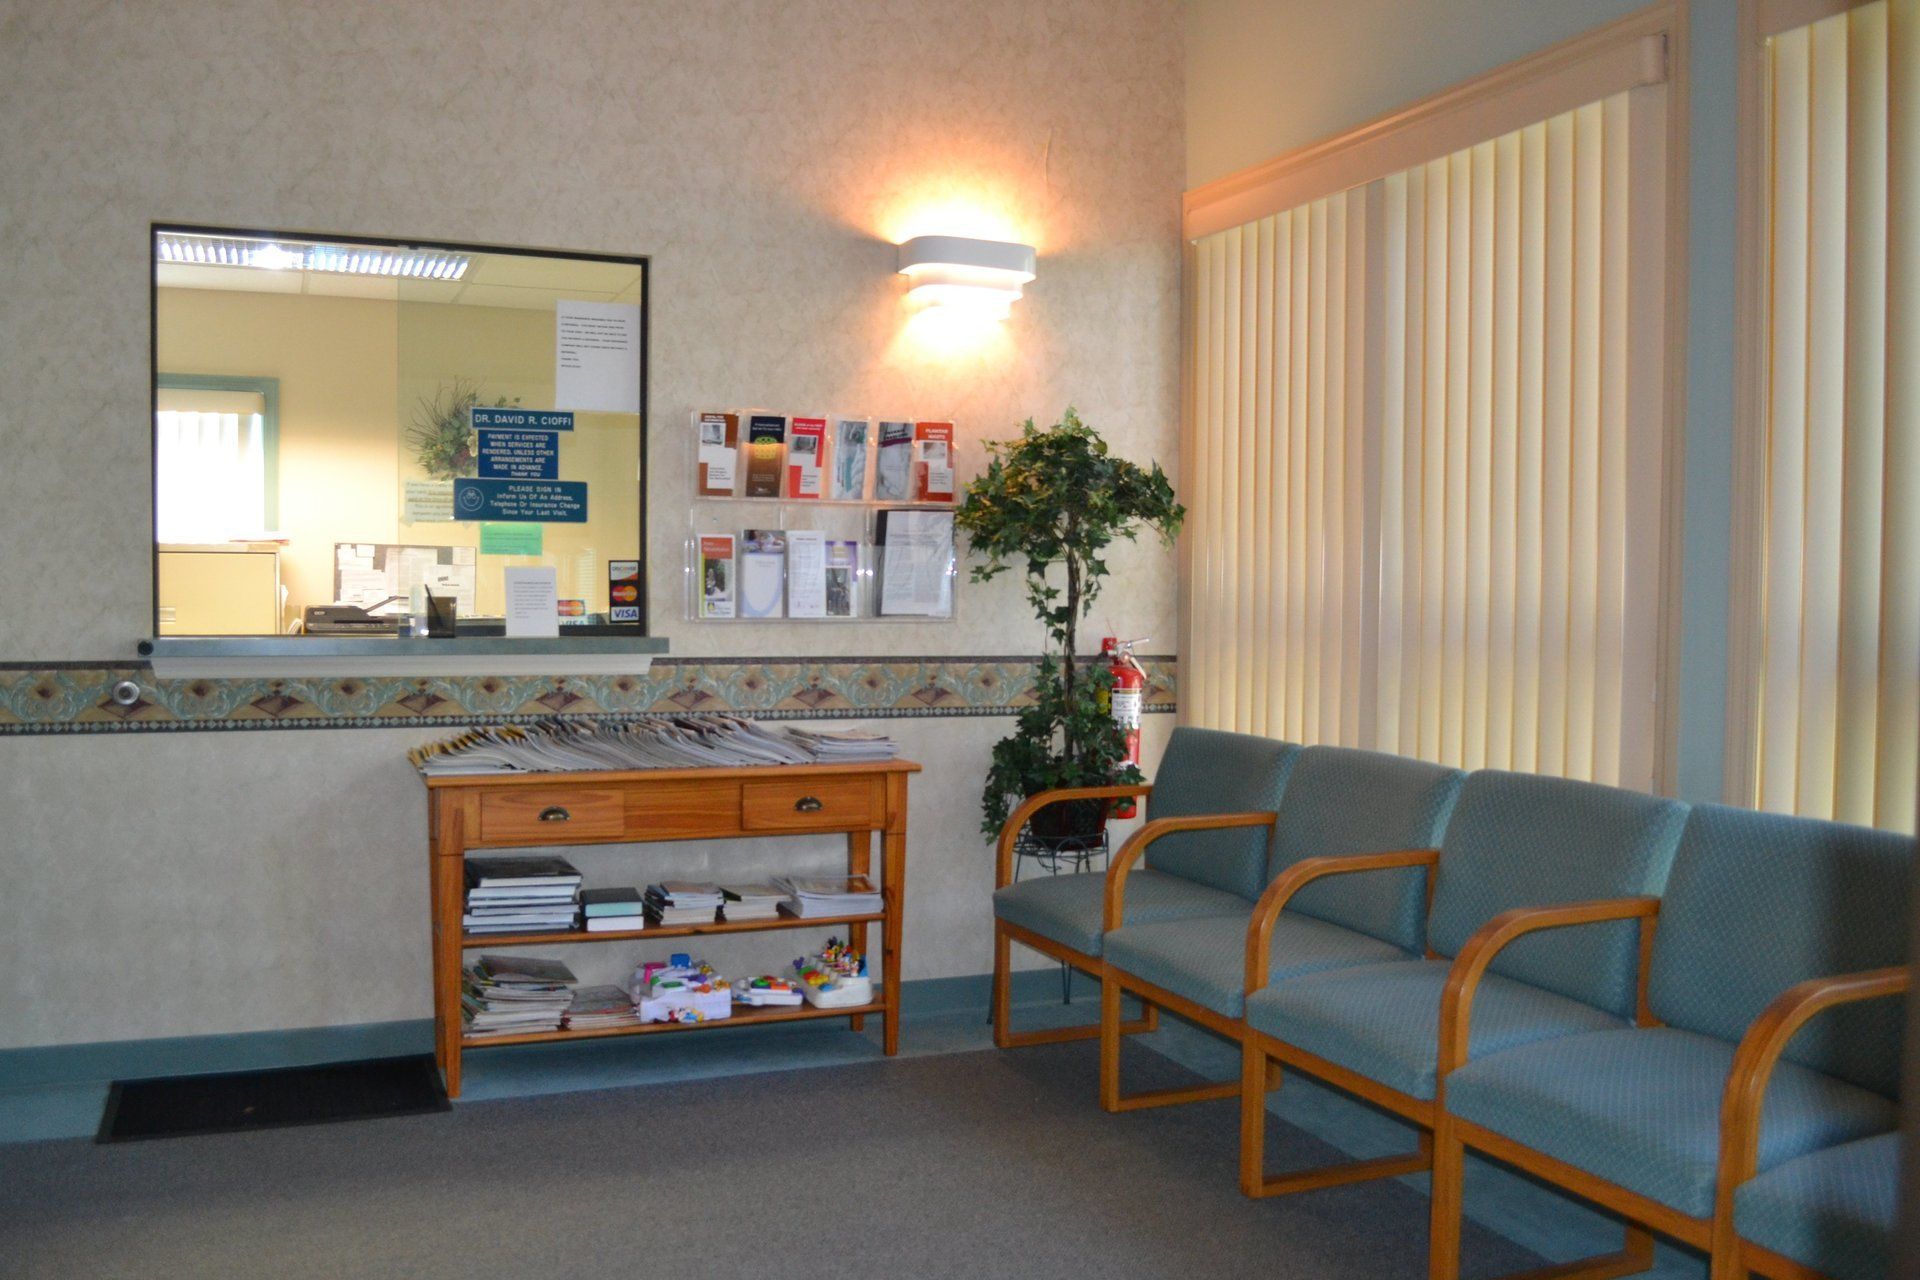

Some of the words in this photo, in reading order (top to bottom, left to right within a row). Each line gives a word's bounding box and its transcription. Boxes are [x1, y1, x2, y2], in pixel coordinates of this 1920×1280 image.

[474, 414, 490, 423] DR.
[494, 415, 525, 424] DAVID
[528, 416, 538, 424] R.
[541, 416, 572, 426] CIOFFI
[614, 609, 638, 618] VISA
